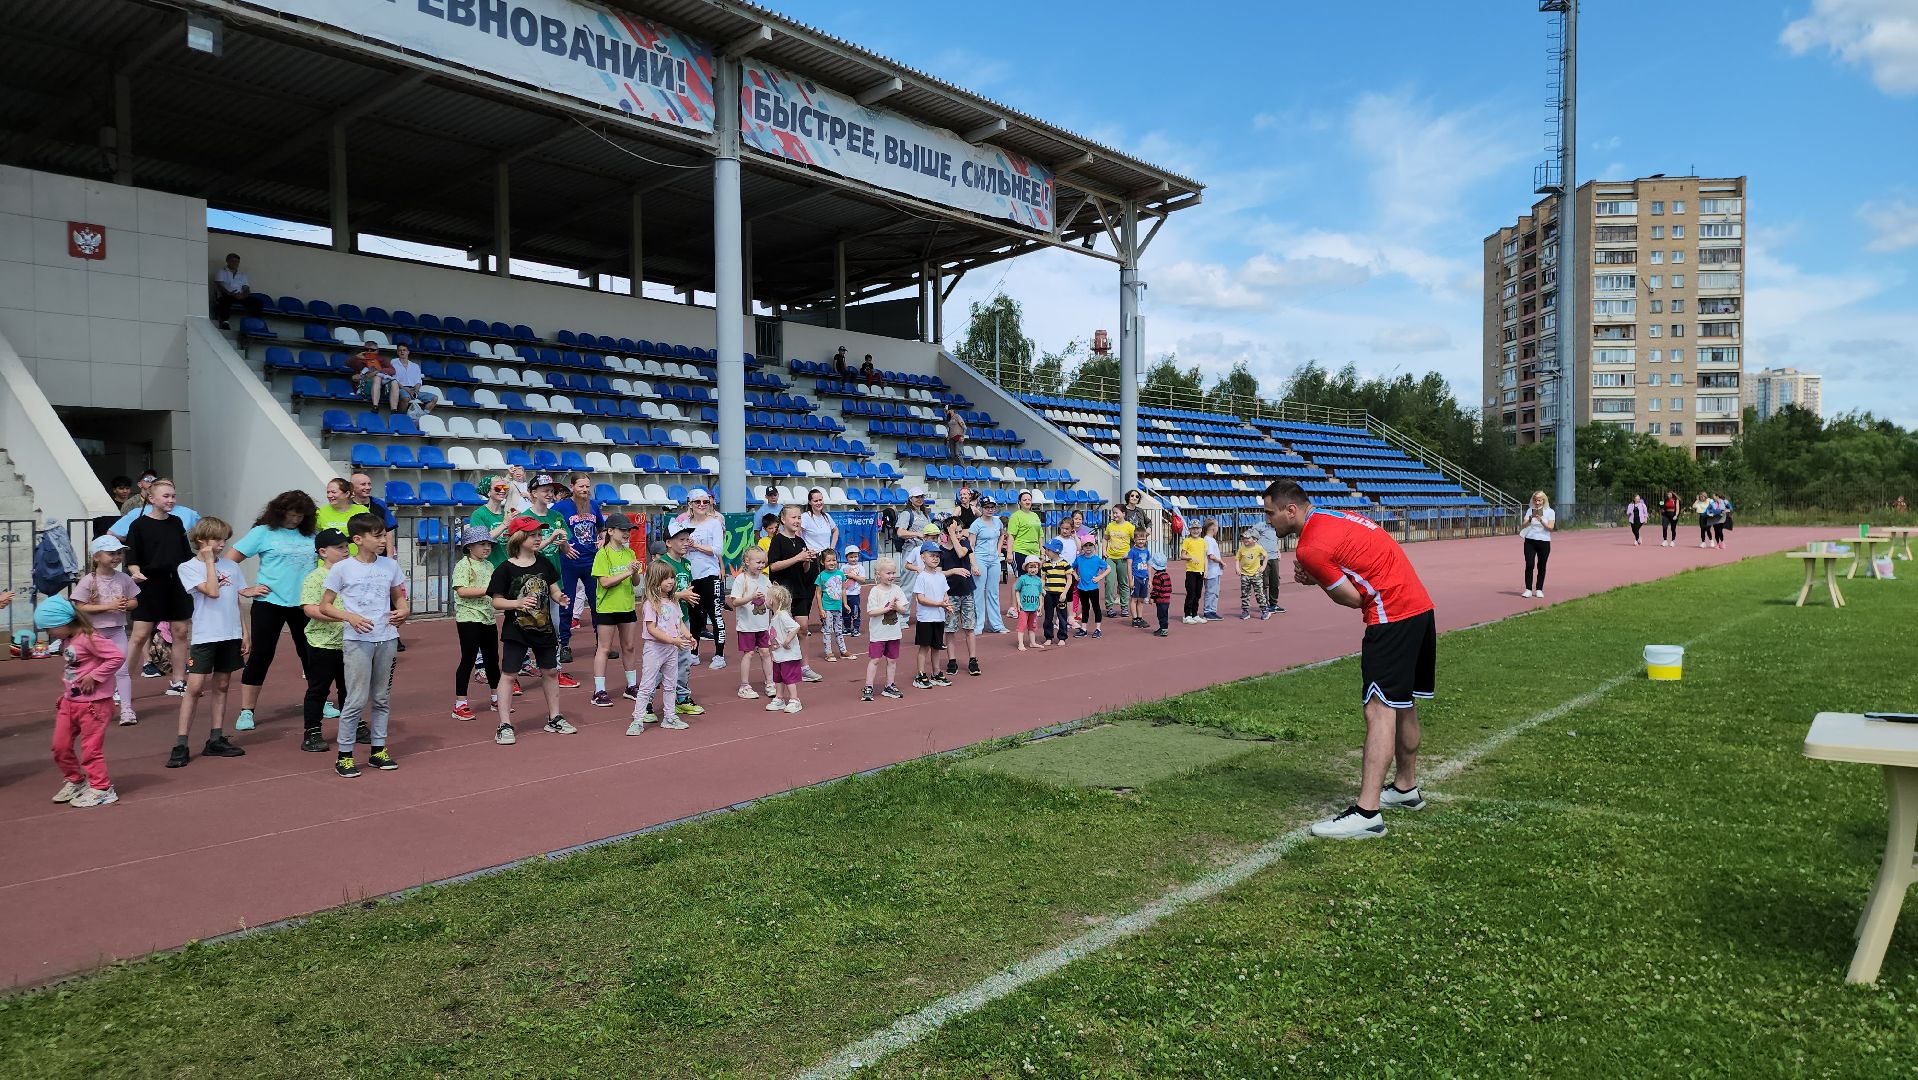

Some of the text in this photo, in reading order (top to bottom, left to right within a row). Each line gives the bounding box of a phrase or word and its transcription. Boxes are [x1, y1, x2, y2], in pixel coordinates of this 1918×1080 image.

[386, 0, 686, 93] ВНОВАНИЙ!
[754, 89, 1050, 210] БЫСТРЕЕ, ВЫШЕ, СИЛЬНЕЕ!
